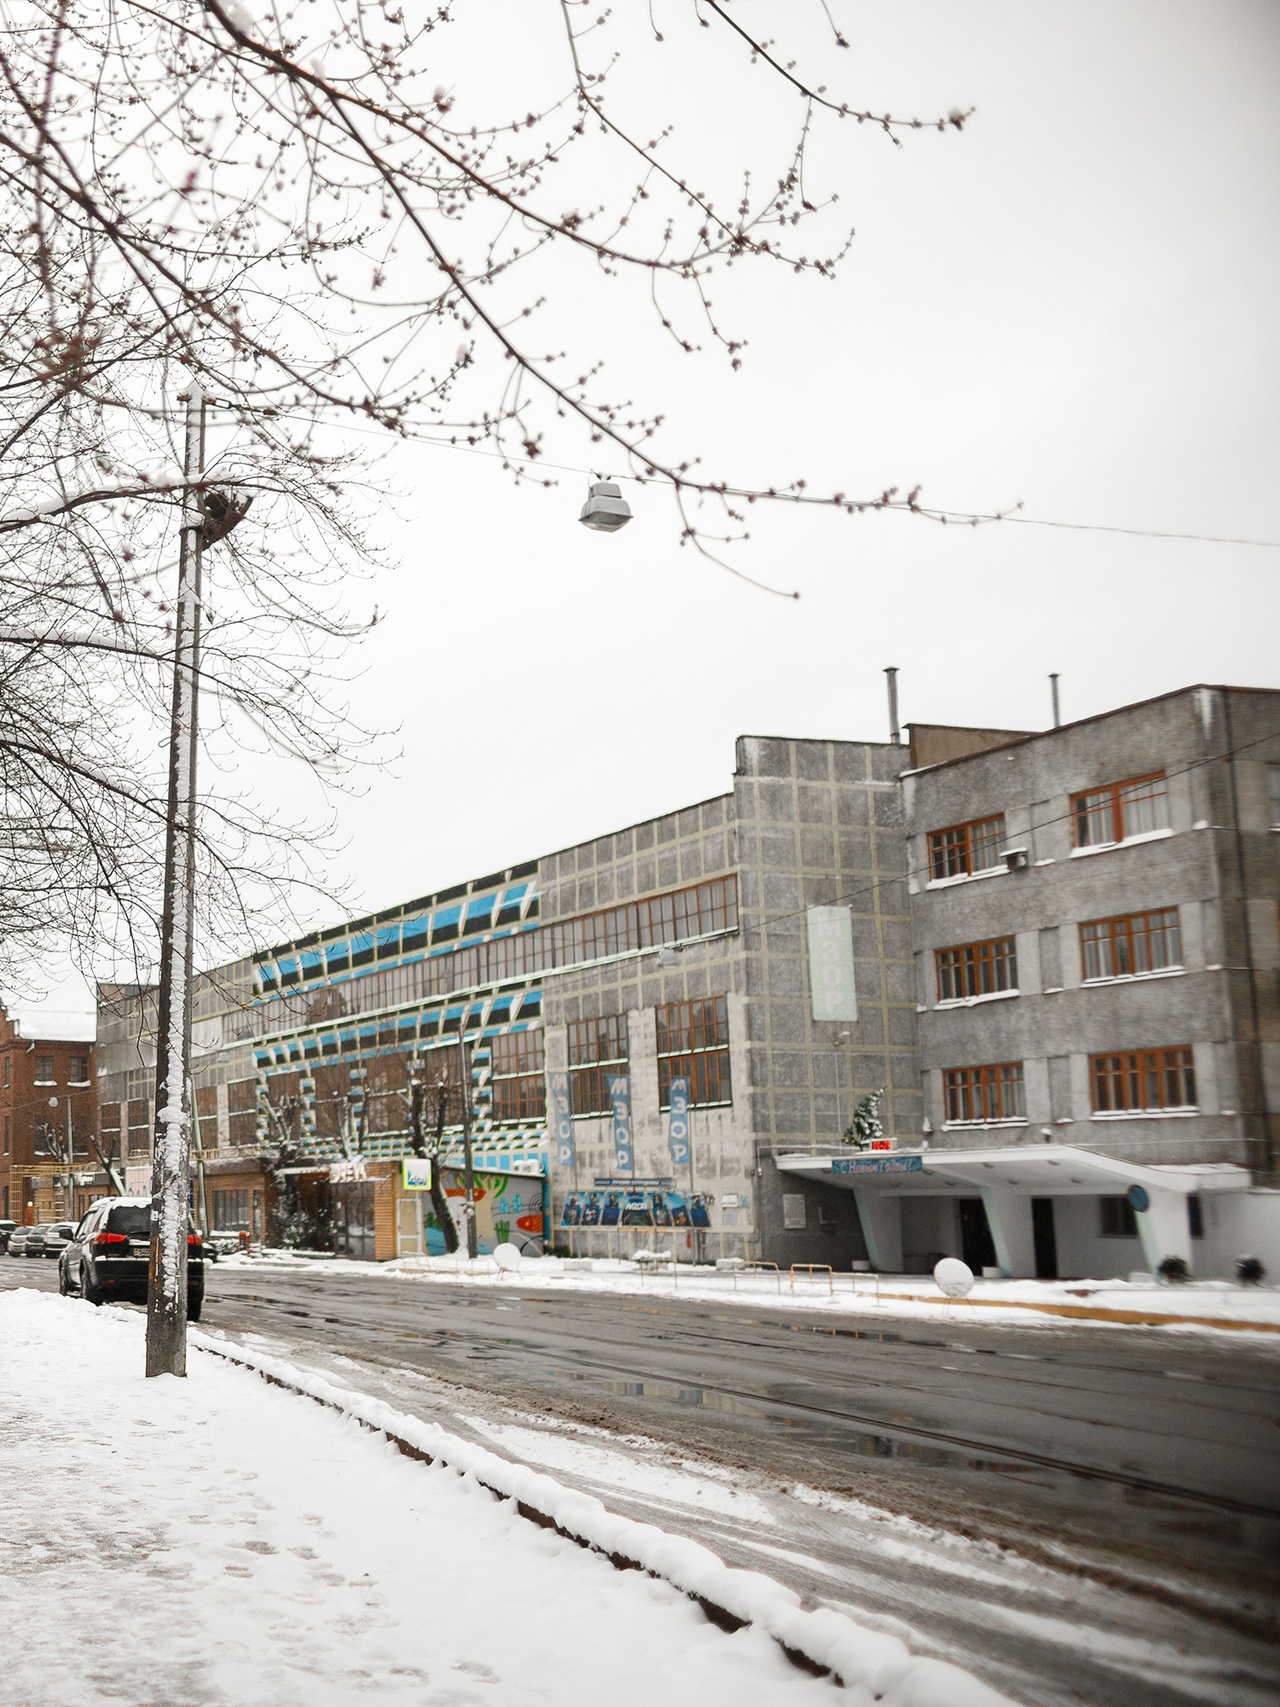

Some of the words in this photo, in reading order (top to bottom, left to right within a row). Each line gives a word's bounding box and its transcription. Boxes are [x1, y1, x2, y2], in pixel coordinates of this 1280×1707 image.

[552, 1074, 571, 1164] МЗОР
[611, 1078, 629, 1167] МЗОР
[671, 1079, 687, 1161] МЗОР
